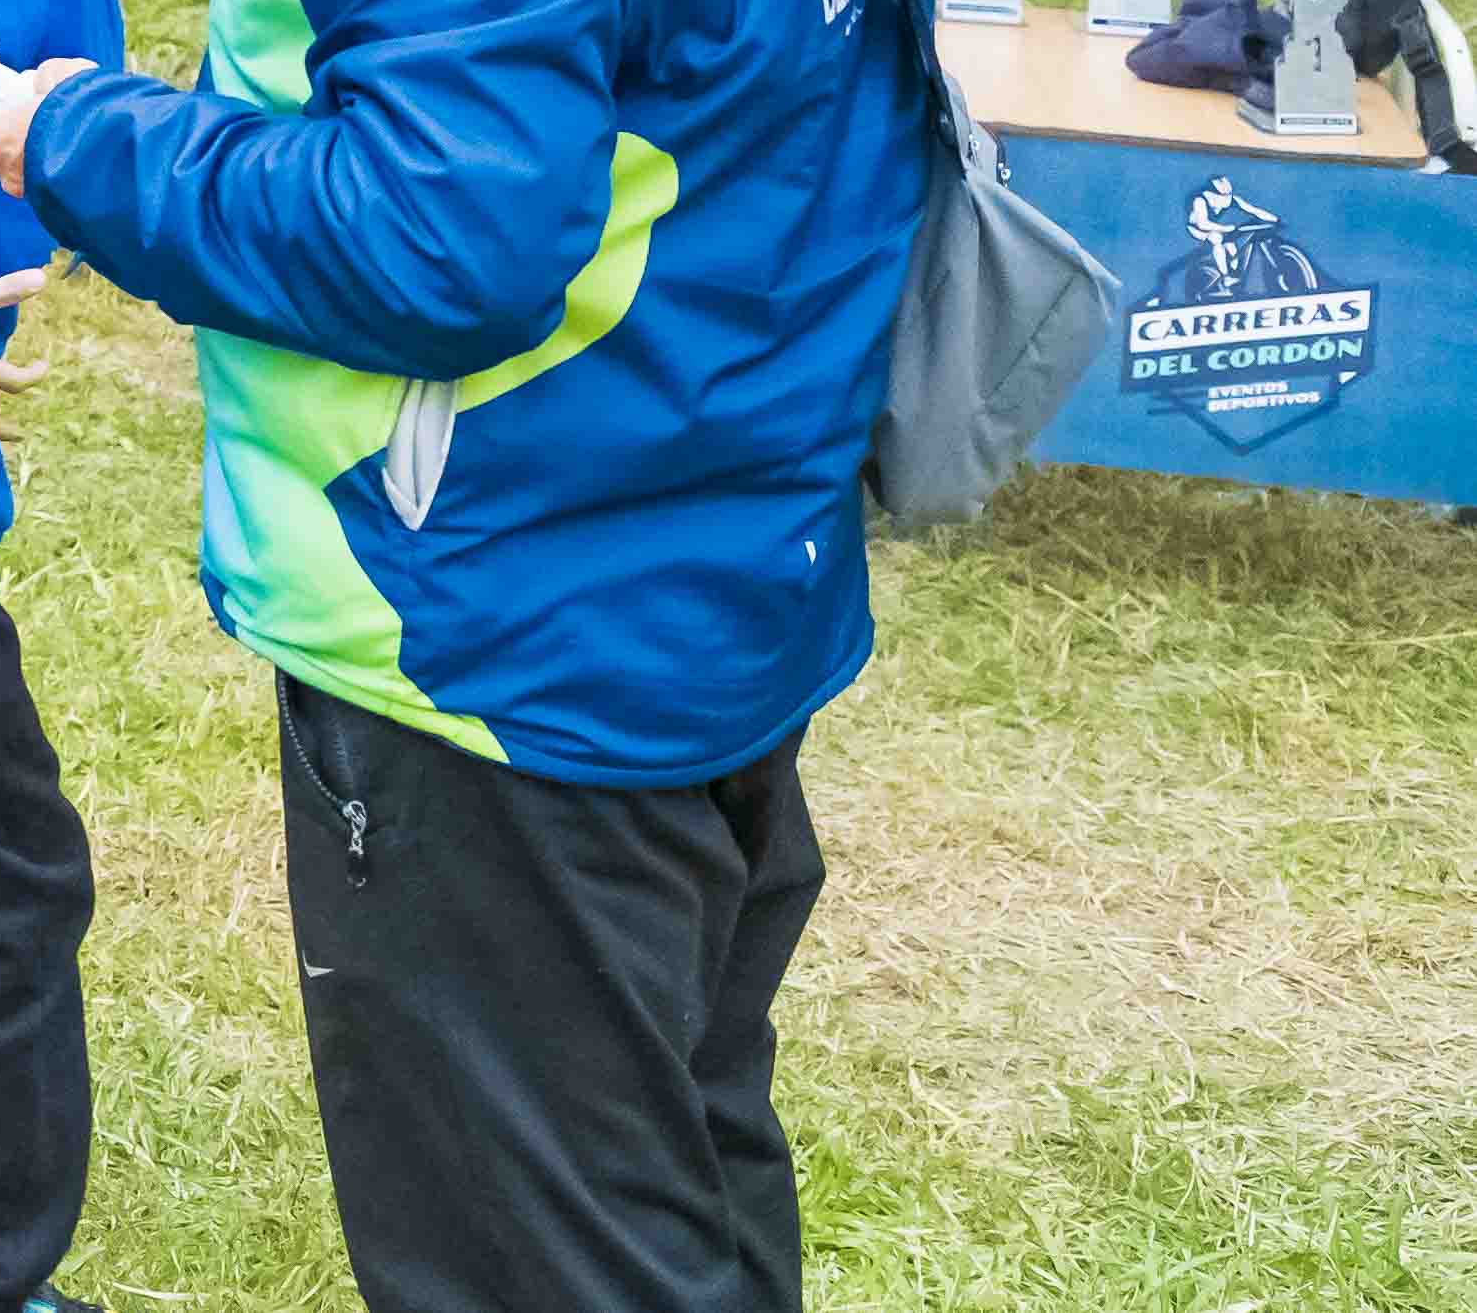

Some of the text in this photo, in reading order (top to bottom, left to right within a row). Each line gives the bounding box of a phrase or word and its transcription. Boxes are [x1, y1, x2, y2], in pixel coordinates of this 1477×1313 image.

[1137, 300, 1362, 341] CARRERAS
[1131, 336, 1363, 379] DEL CORDÓN
